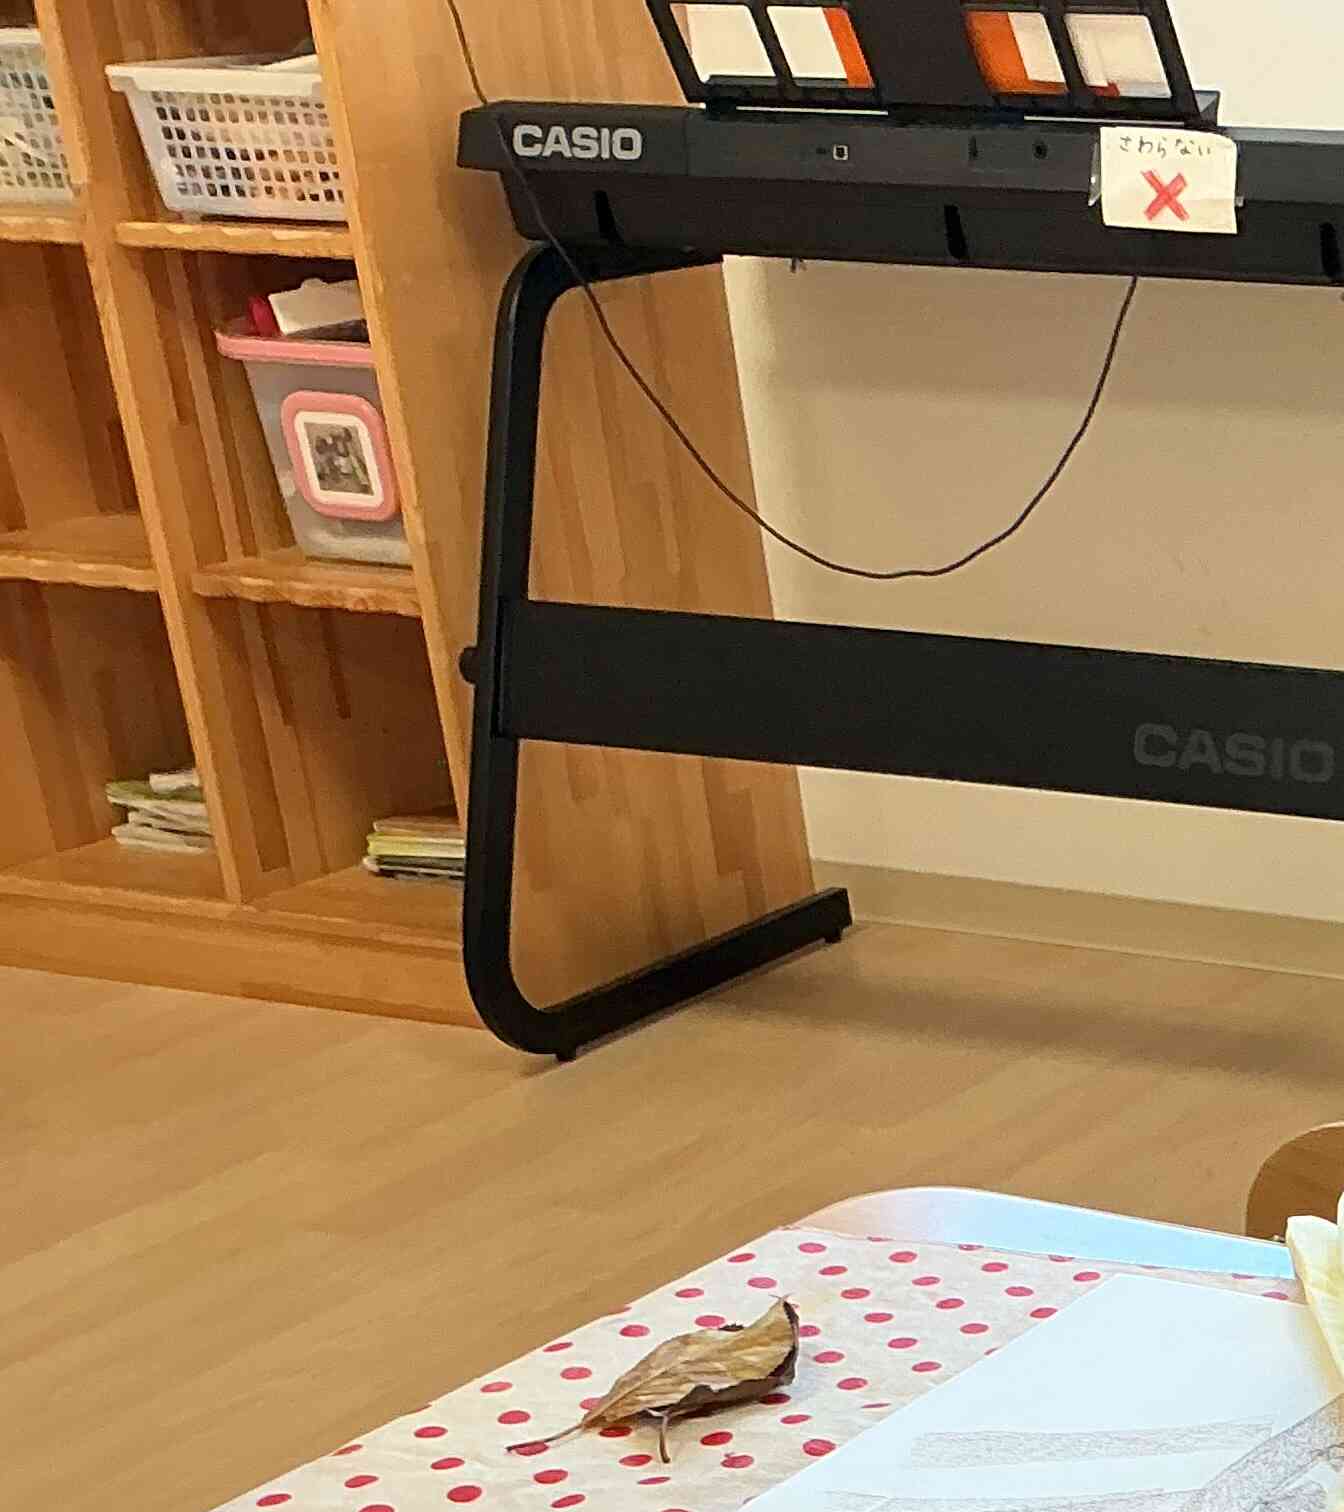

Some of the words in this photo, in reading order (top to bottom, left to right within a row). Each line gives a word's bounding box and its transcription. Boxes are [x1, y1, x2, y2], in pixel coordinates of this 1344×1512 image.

[512, 124, 643, 160] CASIO
[1119, 136, 1211, 159] さわらない
[1134, 722, 1335, 783] CASIO
